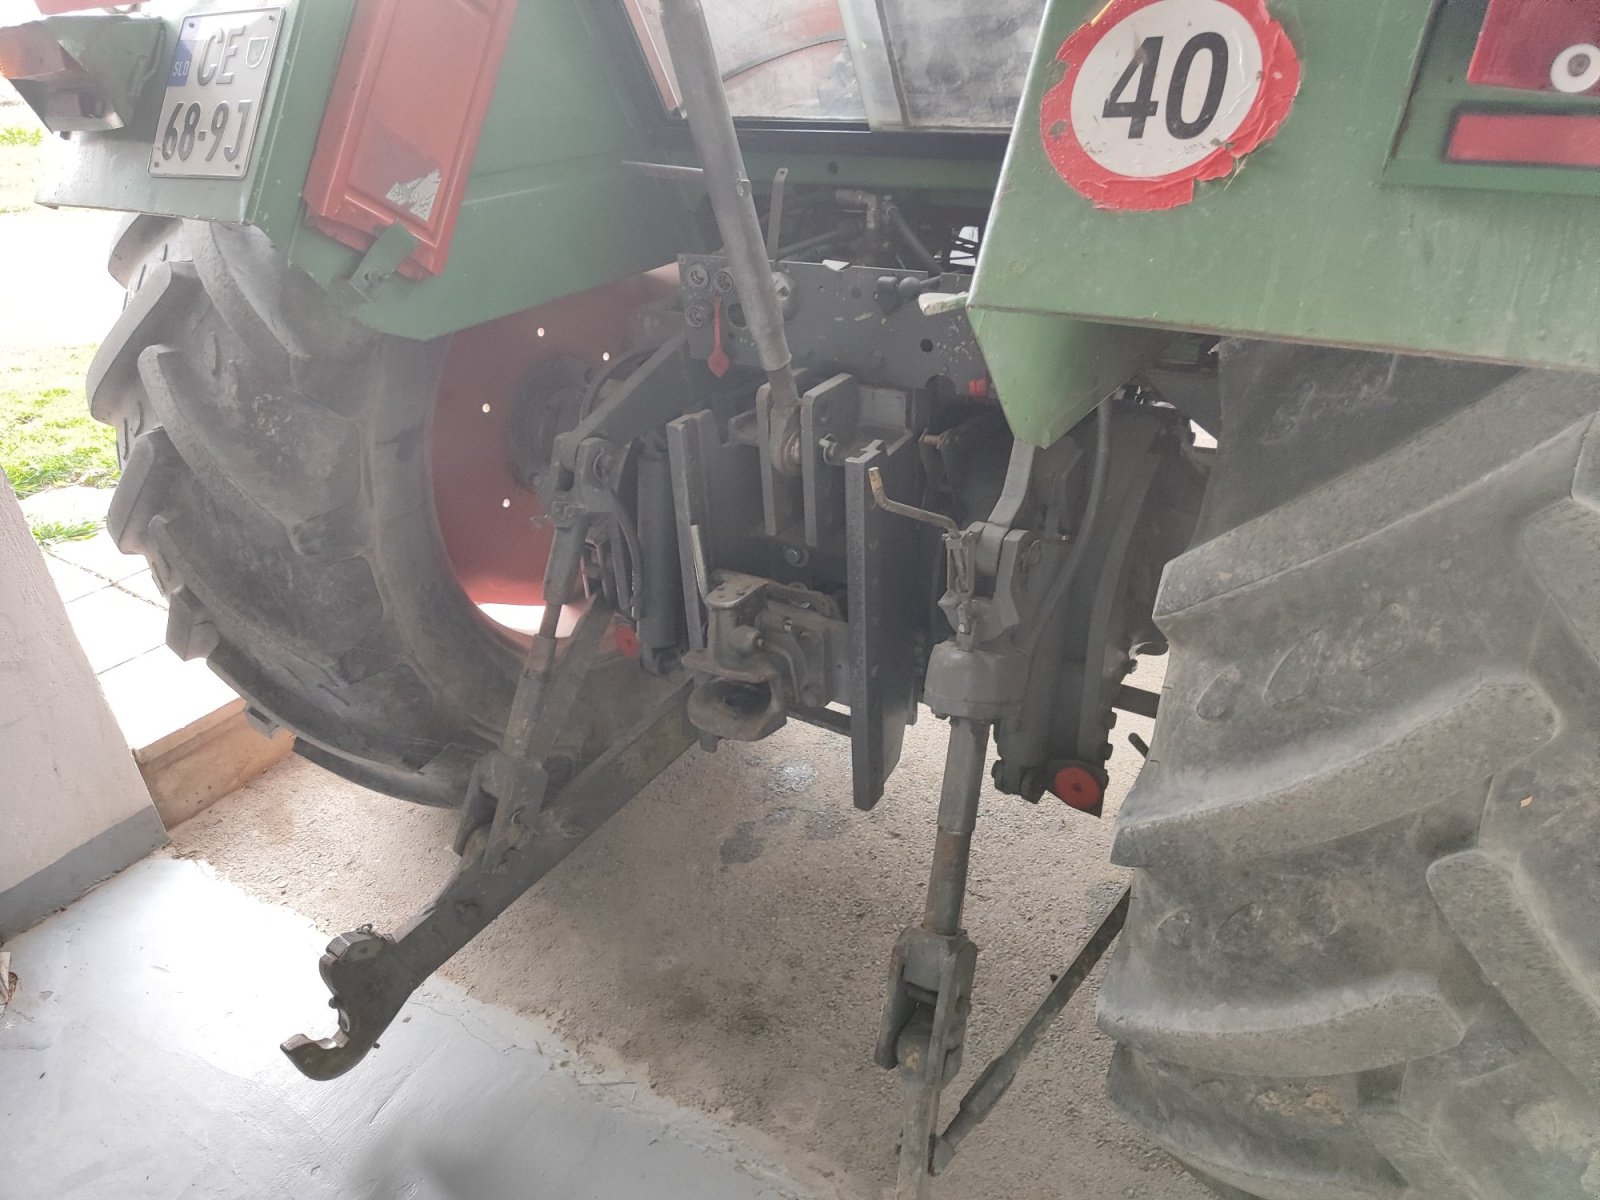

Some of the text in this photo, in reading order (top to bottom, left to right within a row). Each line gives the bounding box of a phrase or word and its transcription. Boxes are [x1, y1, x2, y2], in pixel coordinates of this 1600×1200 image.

[173, 60, 190, 76] SLO
[197, 25, 247, 86] CE
[1102, 32, 1229, 140] 40
[161, 101, 252, 162] 68-9J
